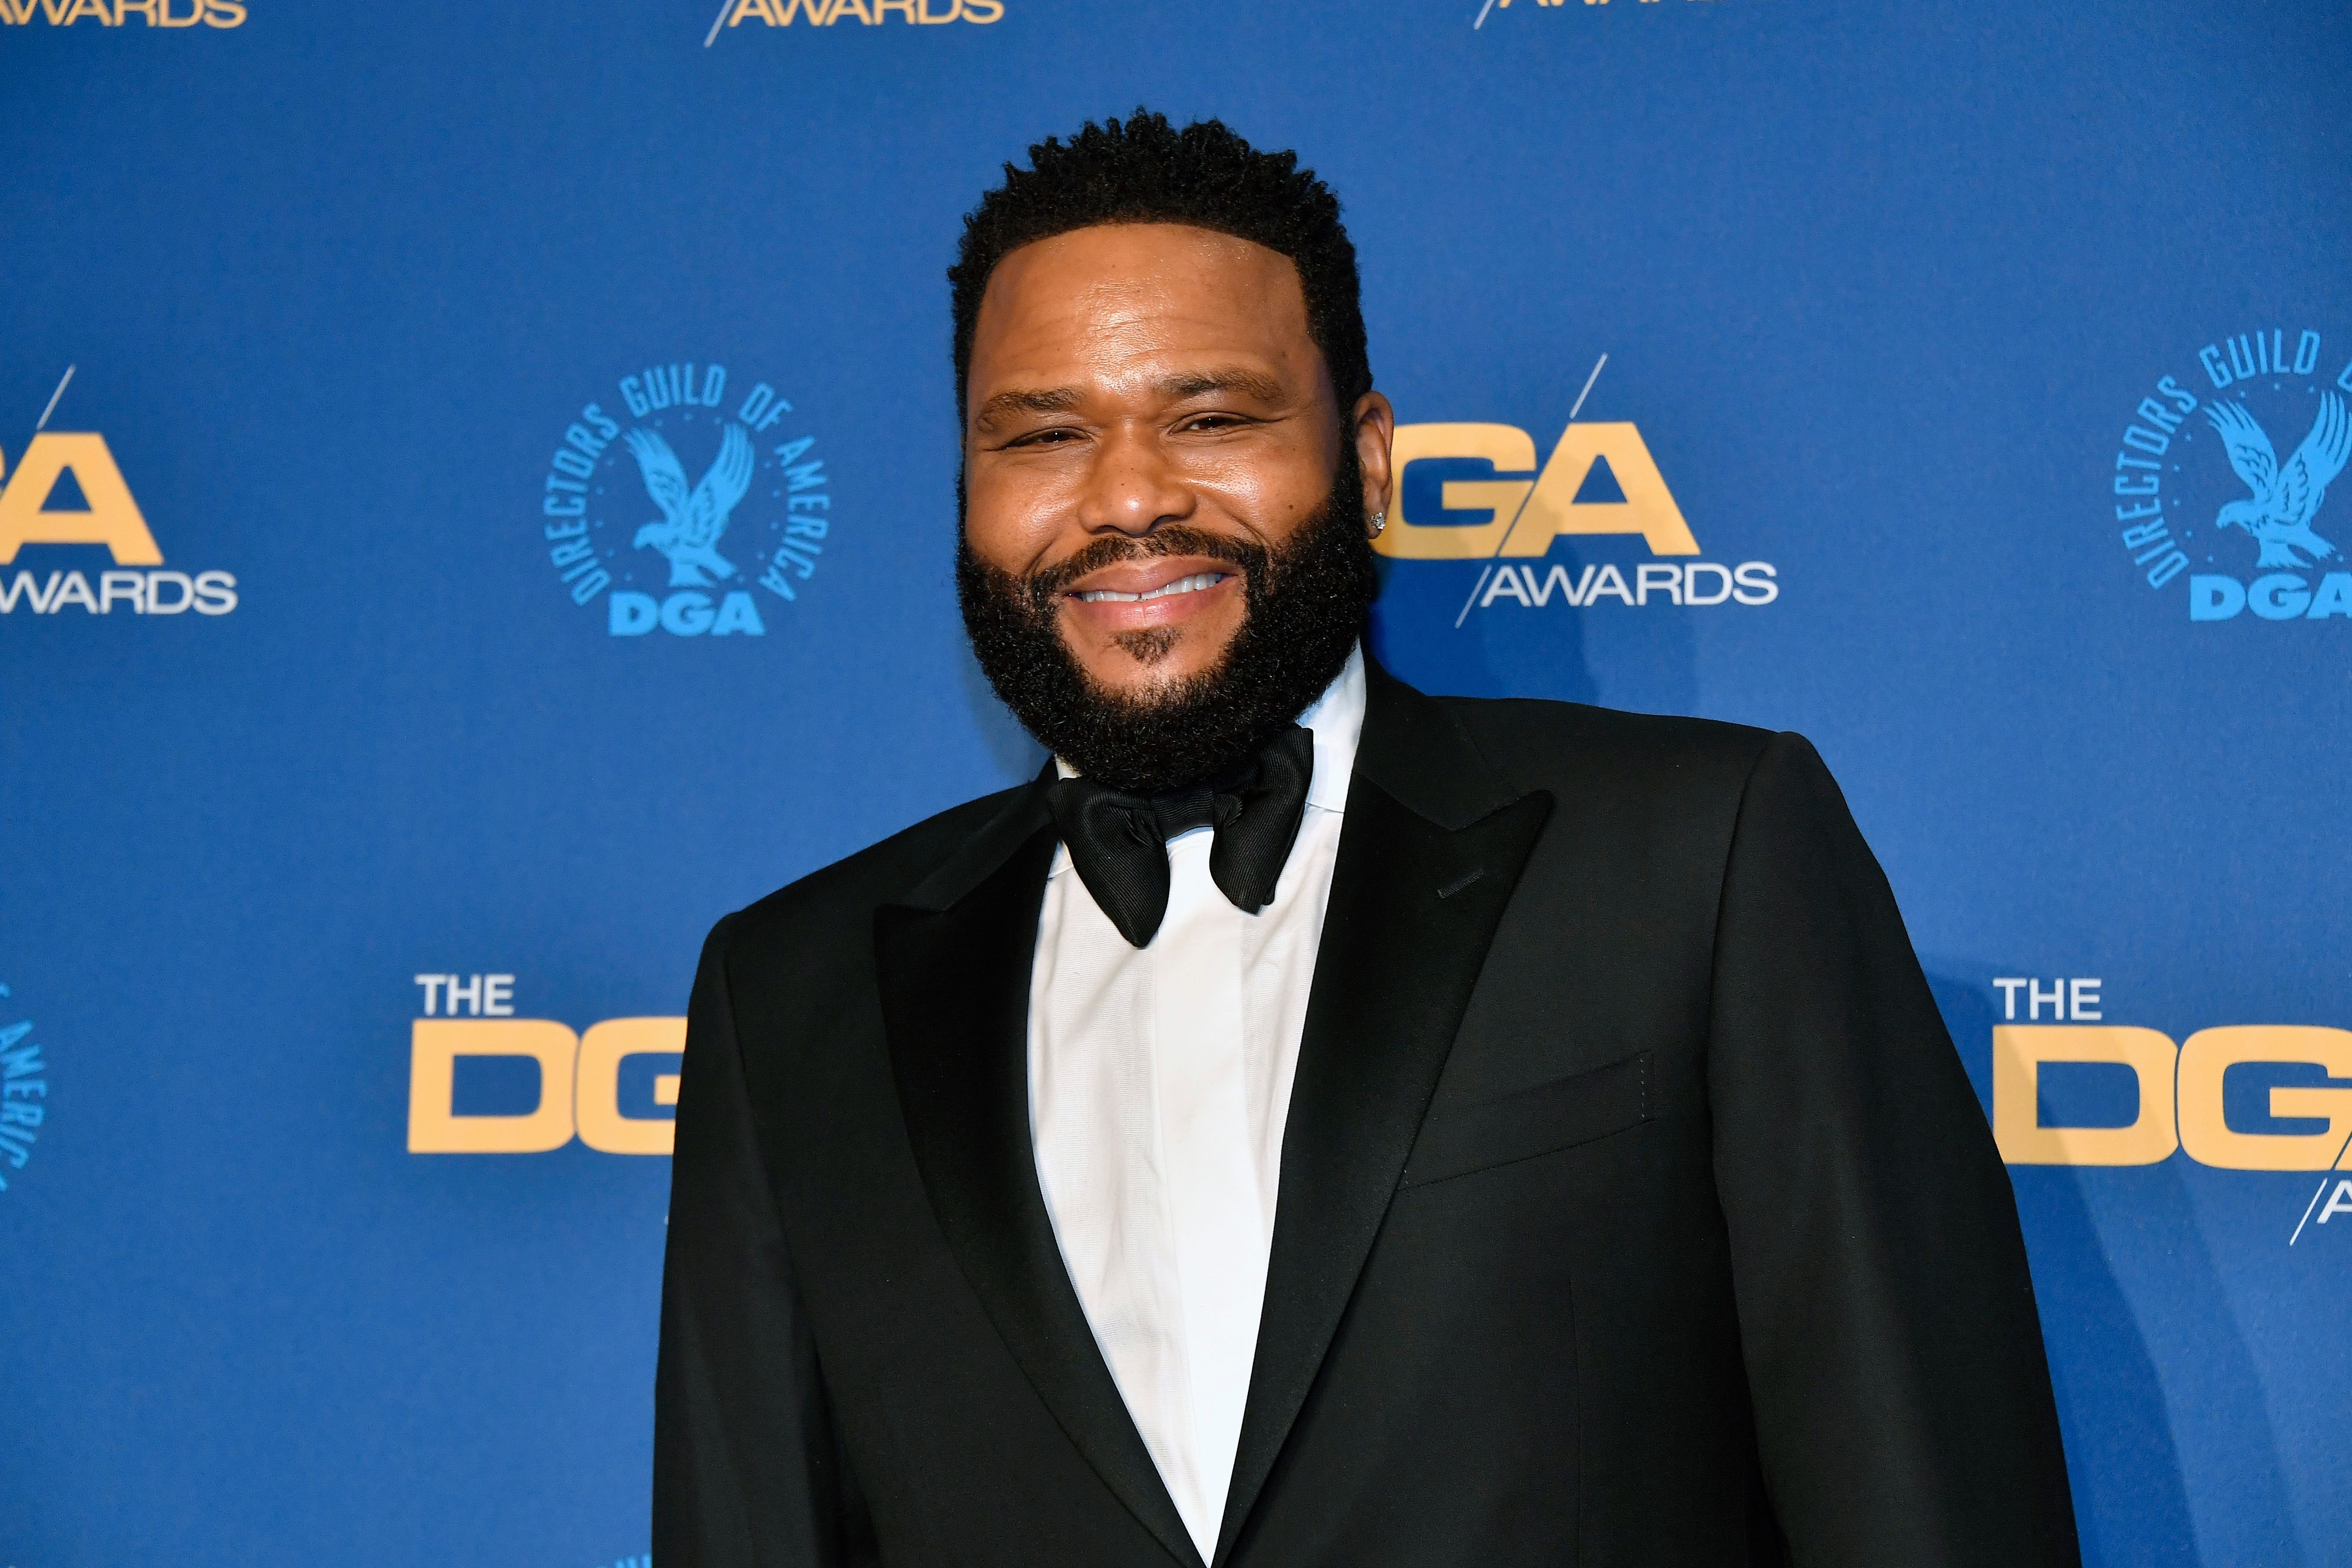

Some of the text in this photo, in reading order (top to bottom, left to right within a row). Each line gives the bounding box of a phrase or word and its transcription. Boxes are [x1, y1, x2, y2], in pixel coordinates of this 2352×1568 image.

[2114, 328, 2321, 590] DIRECTORS GUILD
[543, 363, 830, 606] DIRECTORS GUILD OF AMERICA
[1480, 560, 1779, 608] AWARDS
[2189, 572, 2352, 621] DGA
[609, 590, 766, 637] DGA
[414, 974, 515, 1016] THE
[1993, 978, 2102, 1021] THE
[1992, 1024, 2352, 1171] DG
